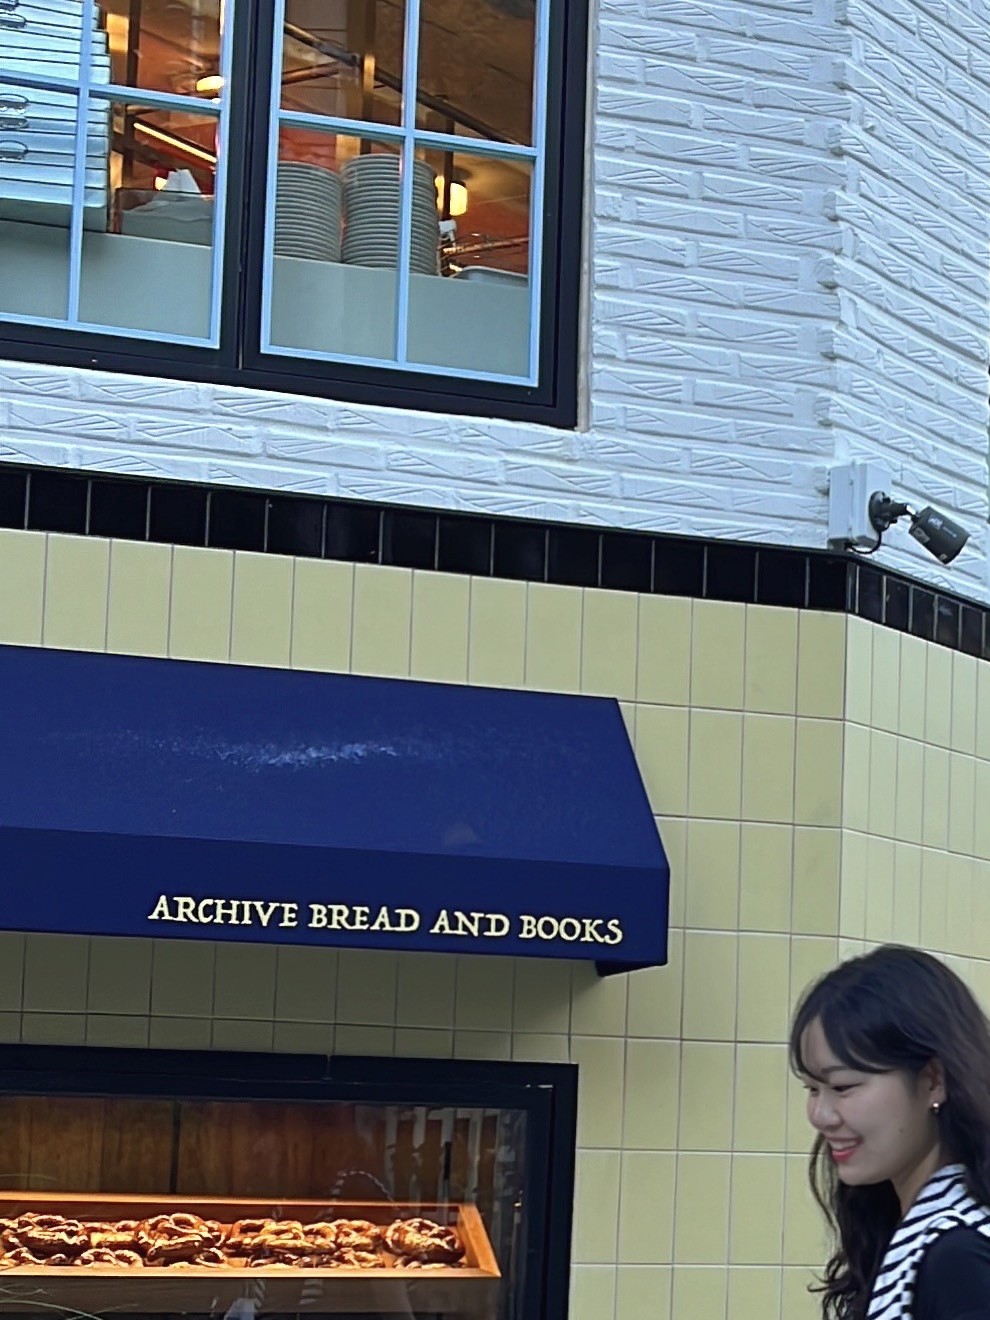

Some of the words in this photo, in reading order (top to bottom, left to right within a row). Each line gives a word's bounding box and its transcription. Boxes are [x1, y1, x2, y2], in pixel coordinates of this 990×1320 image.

[148, 894, 299, 928] ARCHIVE
[307, 903, 420, 932] BREAD
[430, 909, 510, 938] AND
[518, 914, 623, 944] BOOKS
